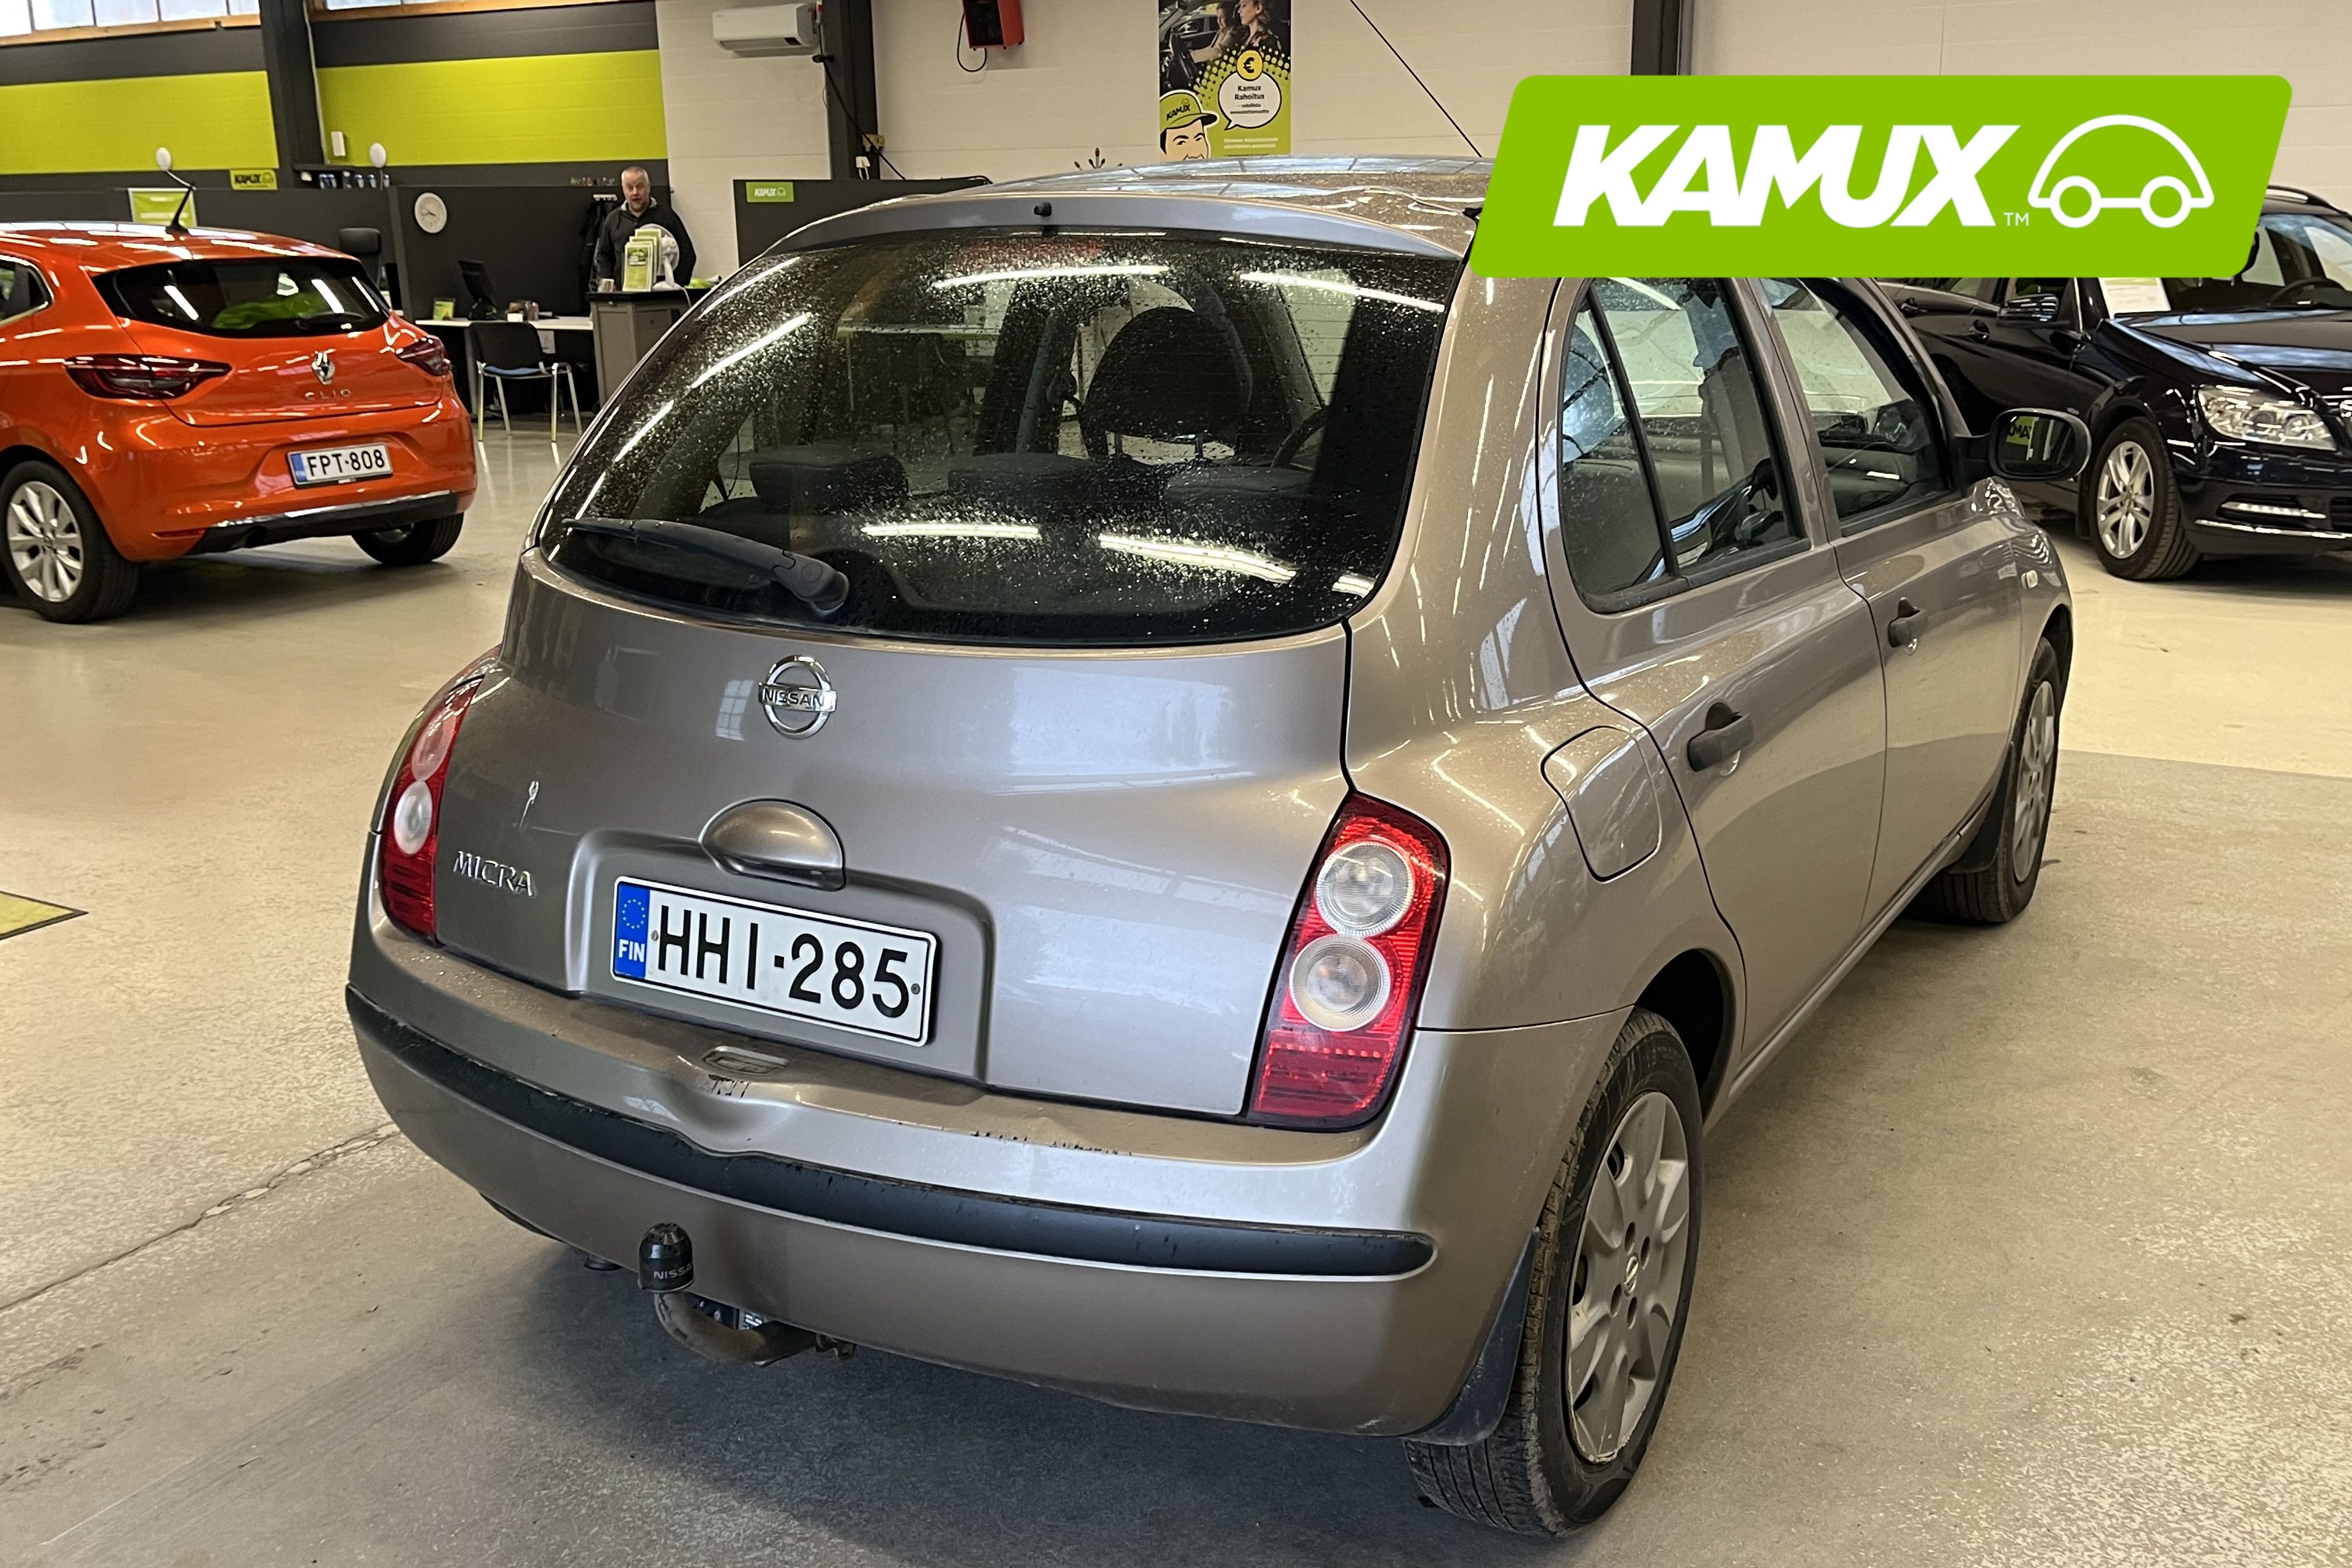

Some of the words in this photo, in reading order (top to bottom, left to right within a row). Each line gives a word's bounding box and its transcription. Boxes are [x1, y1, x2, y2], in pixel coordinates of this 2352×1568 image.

[1166, 104, 1191, 121] KAMUX
[304, 388, 351, 401] CLIO
[306, 449, 386, 477] FPT-808
[762, 688, 825, 708] NISSAN
[453, 850, 534, 897] MICRA
[617, 937, 645, 963] FIN
[657, 905, 910, 1019] HHI-285
[653, 1264, 692, 1280] NISSA
